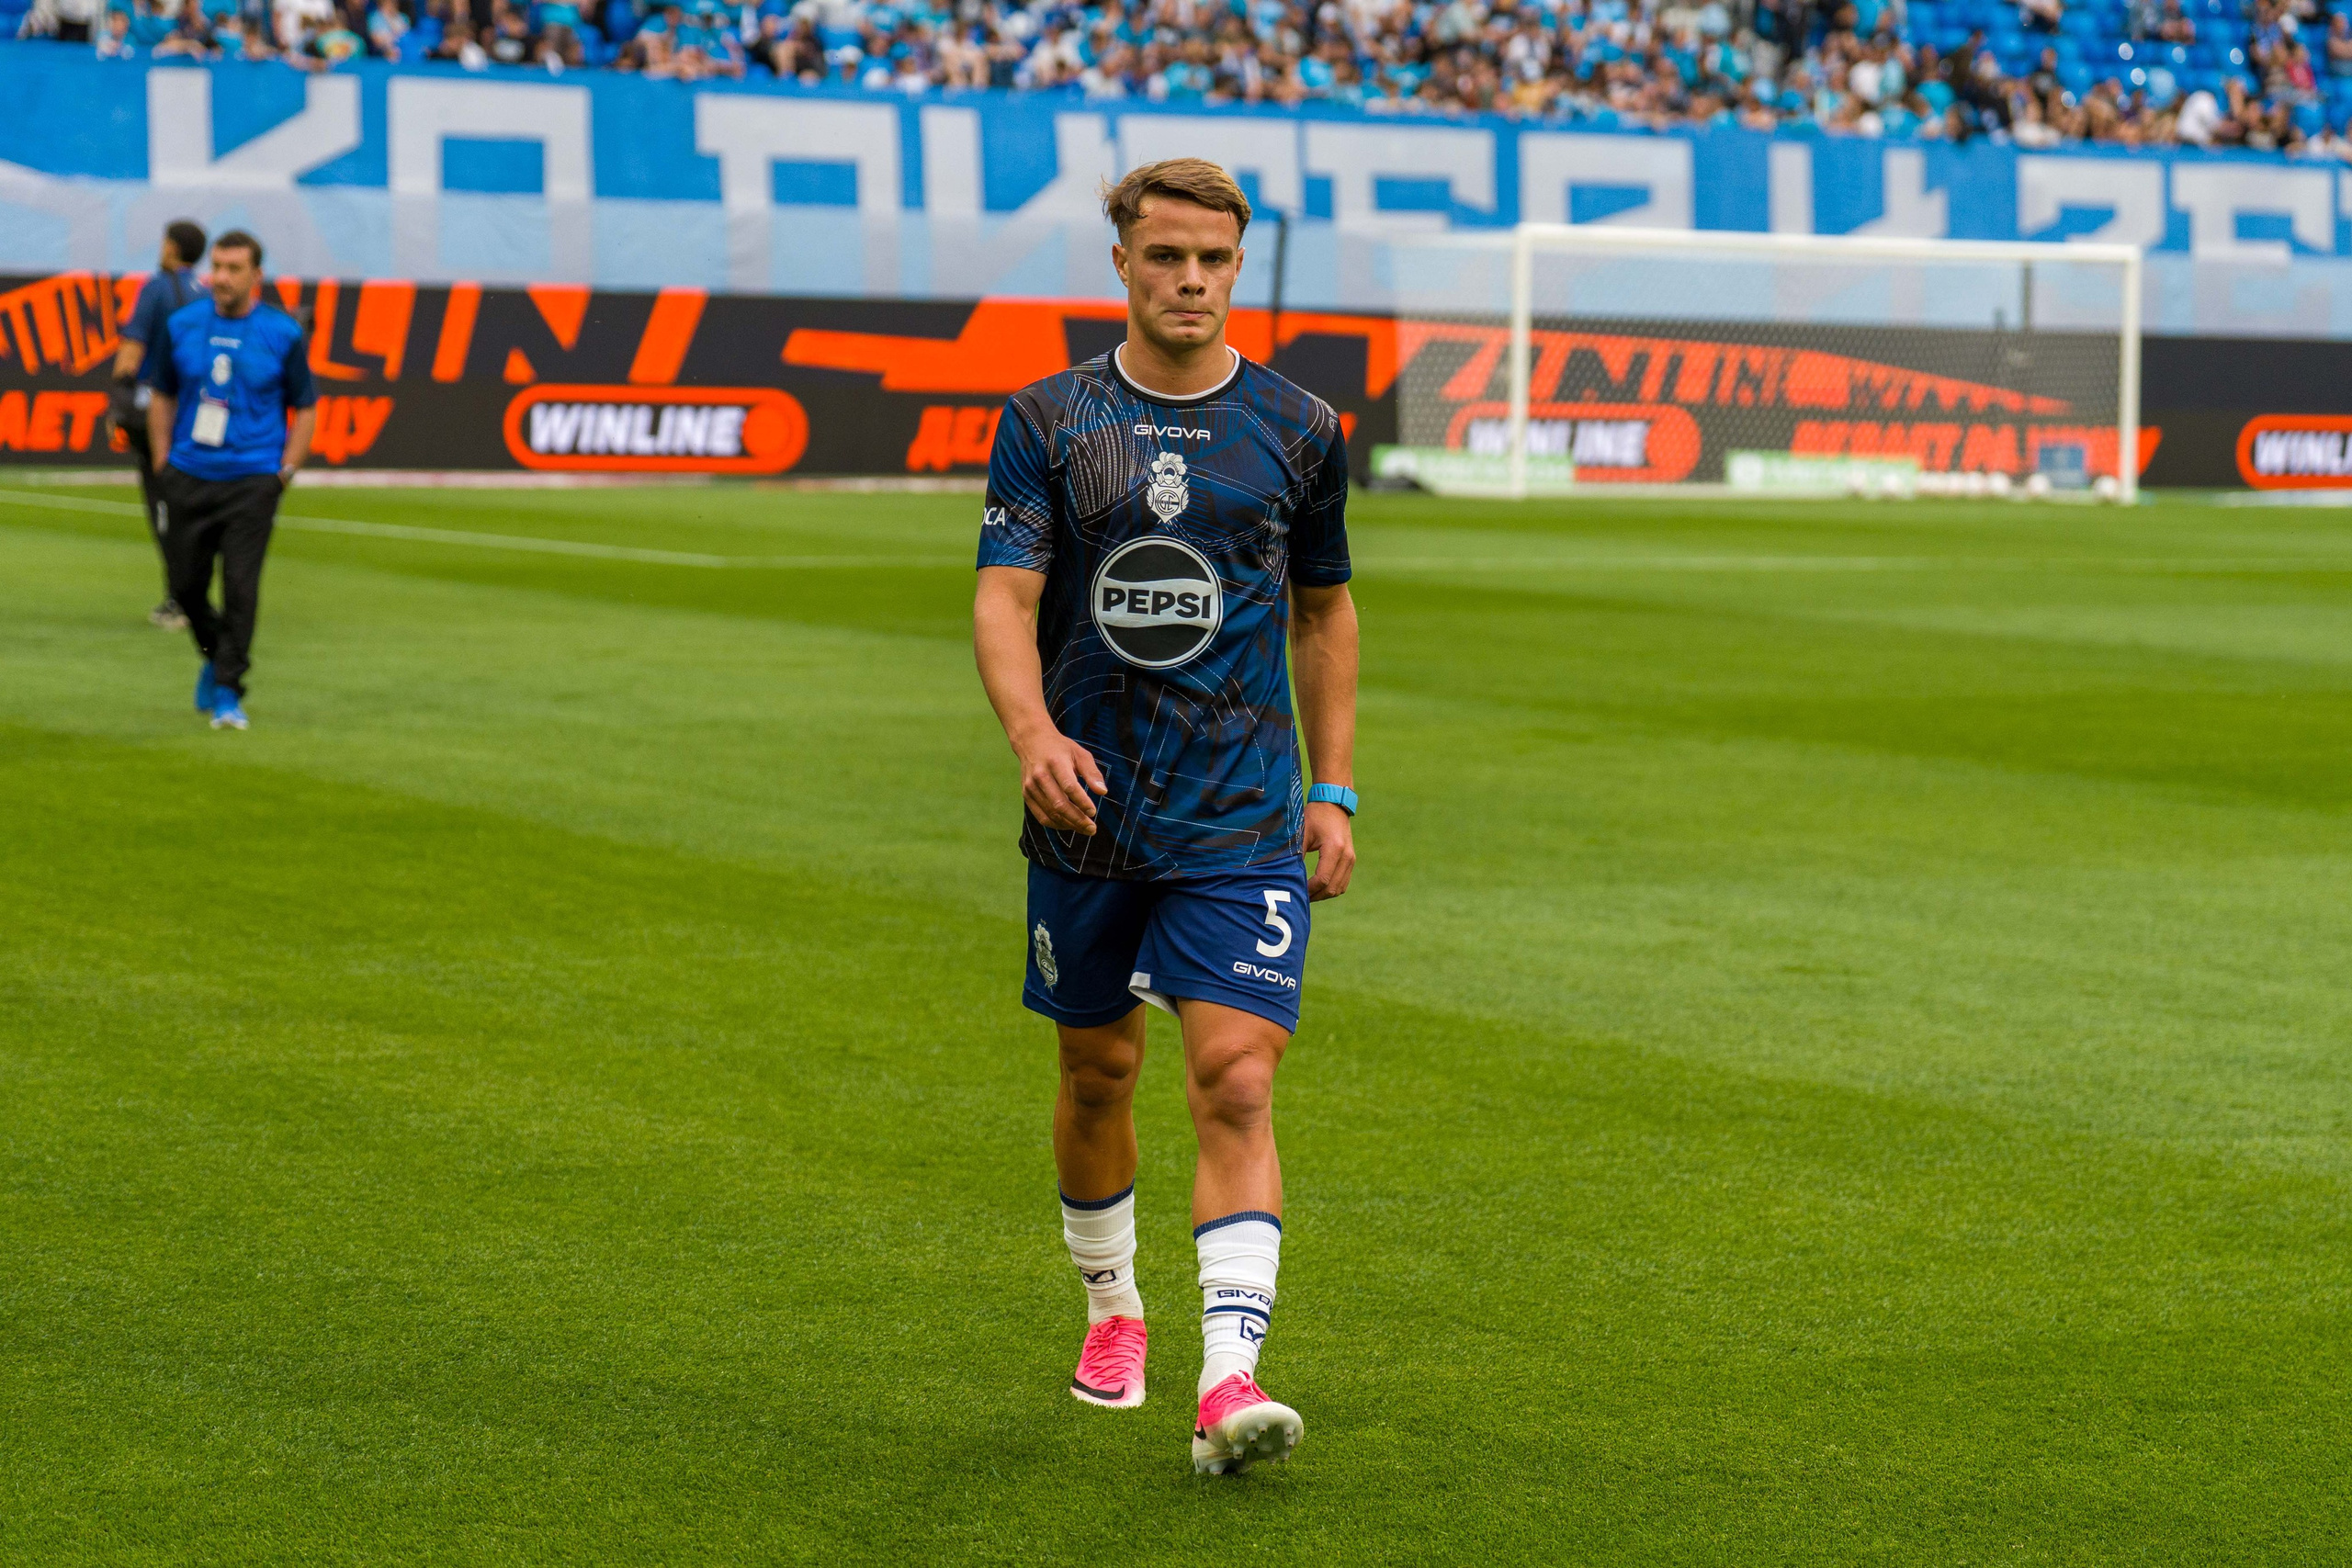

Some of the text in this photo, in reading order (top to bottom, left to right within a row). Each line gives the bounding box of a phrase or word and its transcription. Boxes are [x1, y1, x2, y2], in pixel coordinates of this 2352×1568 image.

[530, 401, 743, 457] WINLINE
[1134, 423, 1211, 441] GIVOVA
[1102, 588, 1211, 619] PEPSI
[1257, 891, 1292, 957] 5
[1233, 962, 1296, 990] GIVOVA
[1216, 1289, 1272, 1312] GIVO
